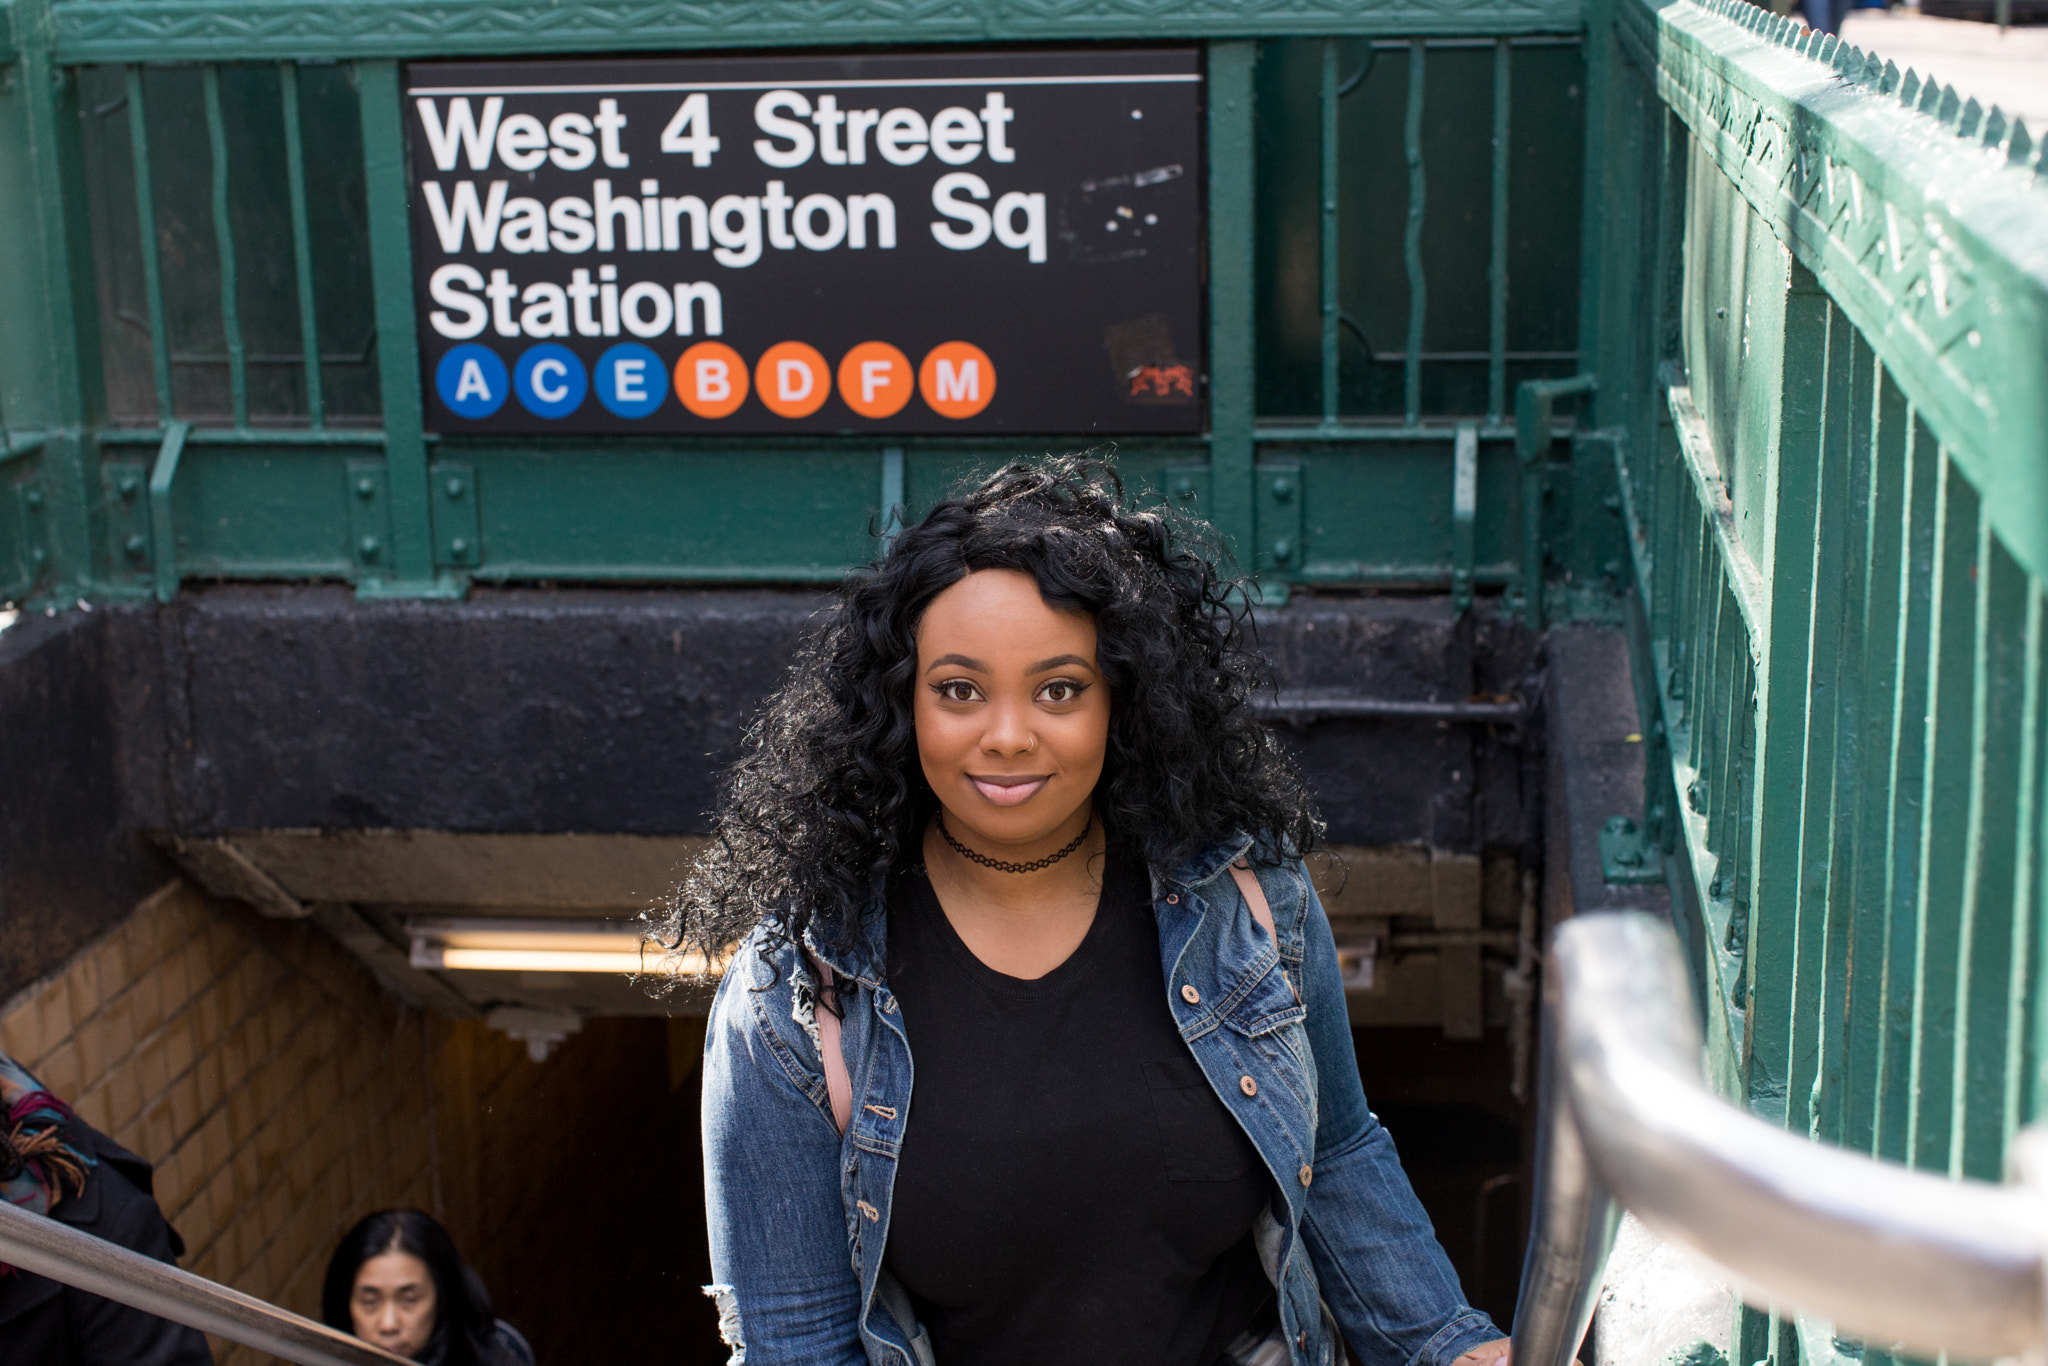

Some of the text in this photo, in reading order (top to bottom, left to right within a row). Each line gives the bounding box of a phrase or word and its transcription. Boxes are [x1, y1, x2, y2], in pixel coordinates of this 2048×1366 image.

[417, 89, 1016, 170] West 4 Street
[423, 172, 1047, 268] Washington Sq
[429, 264, 724, 339] Station
[456, 359, 980, 402] A C E B D F M
